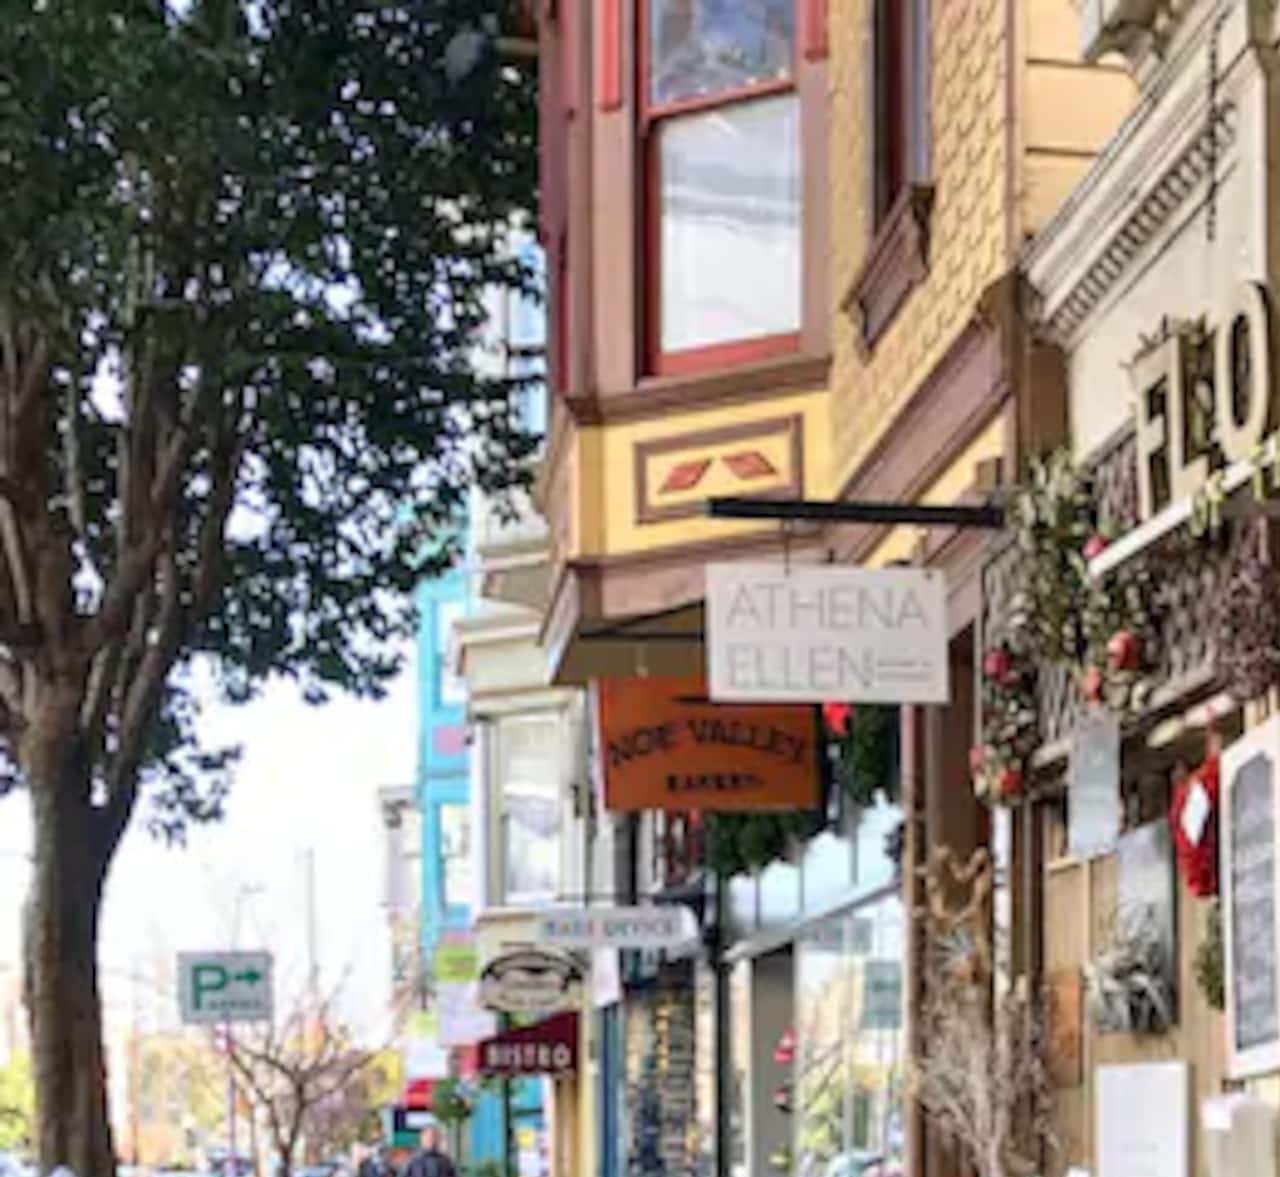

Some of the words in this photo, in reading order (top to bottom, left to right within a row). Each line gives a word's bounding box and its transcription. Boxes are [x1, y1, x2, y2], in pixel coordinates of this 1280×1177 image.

[726, 583, 928, 630] ATHENA
[726, 643, 874, 690] ELLEN
[687, 718, 806, 763] VALLEY
